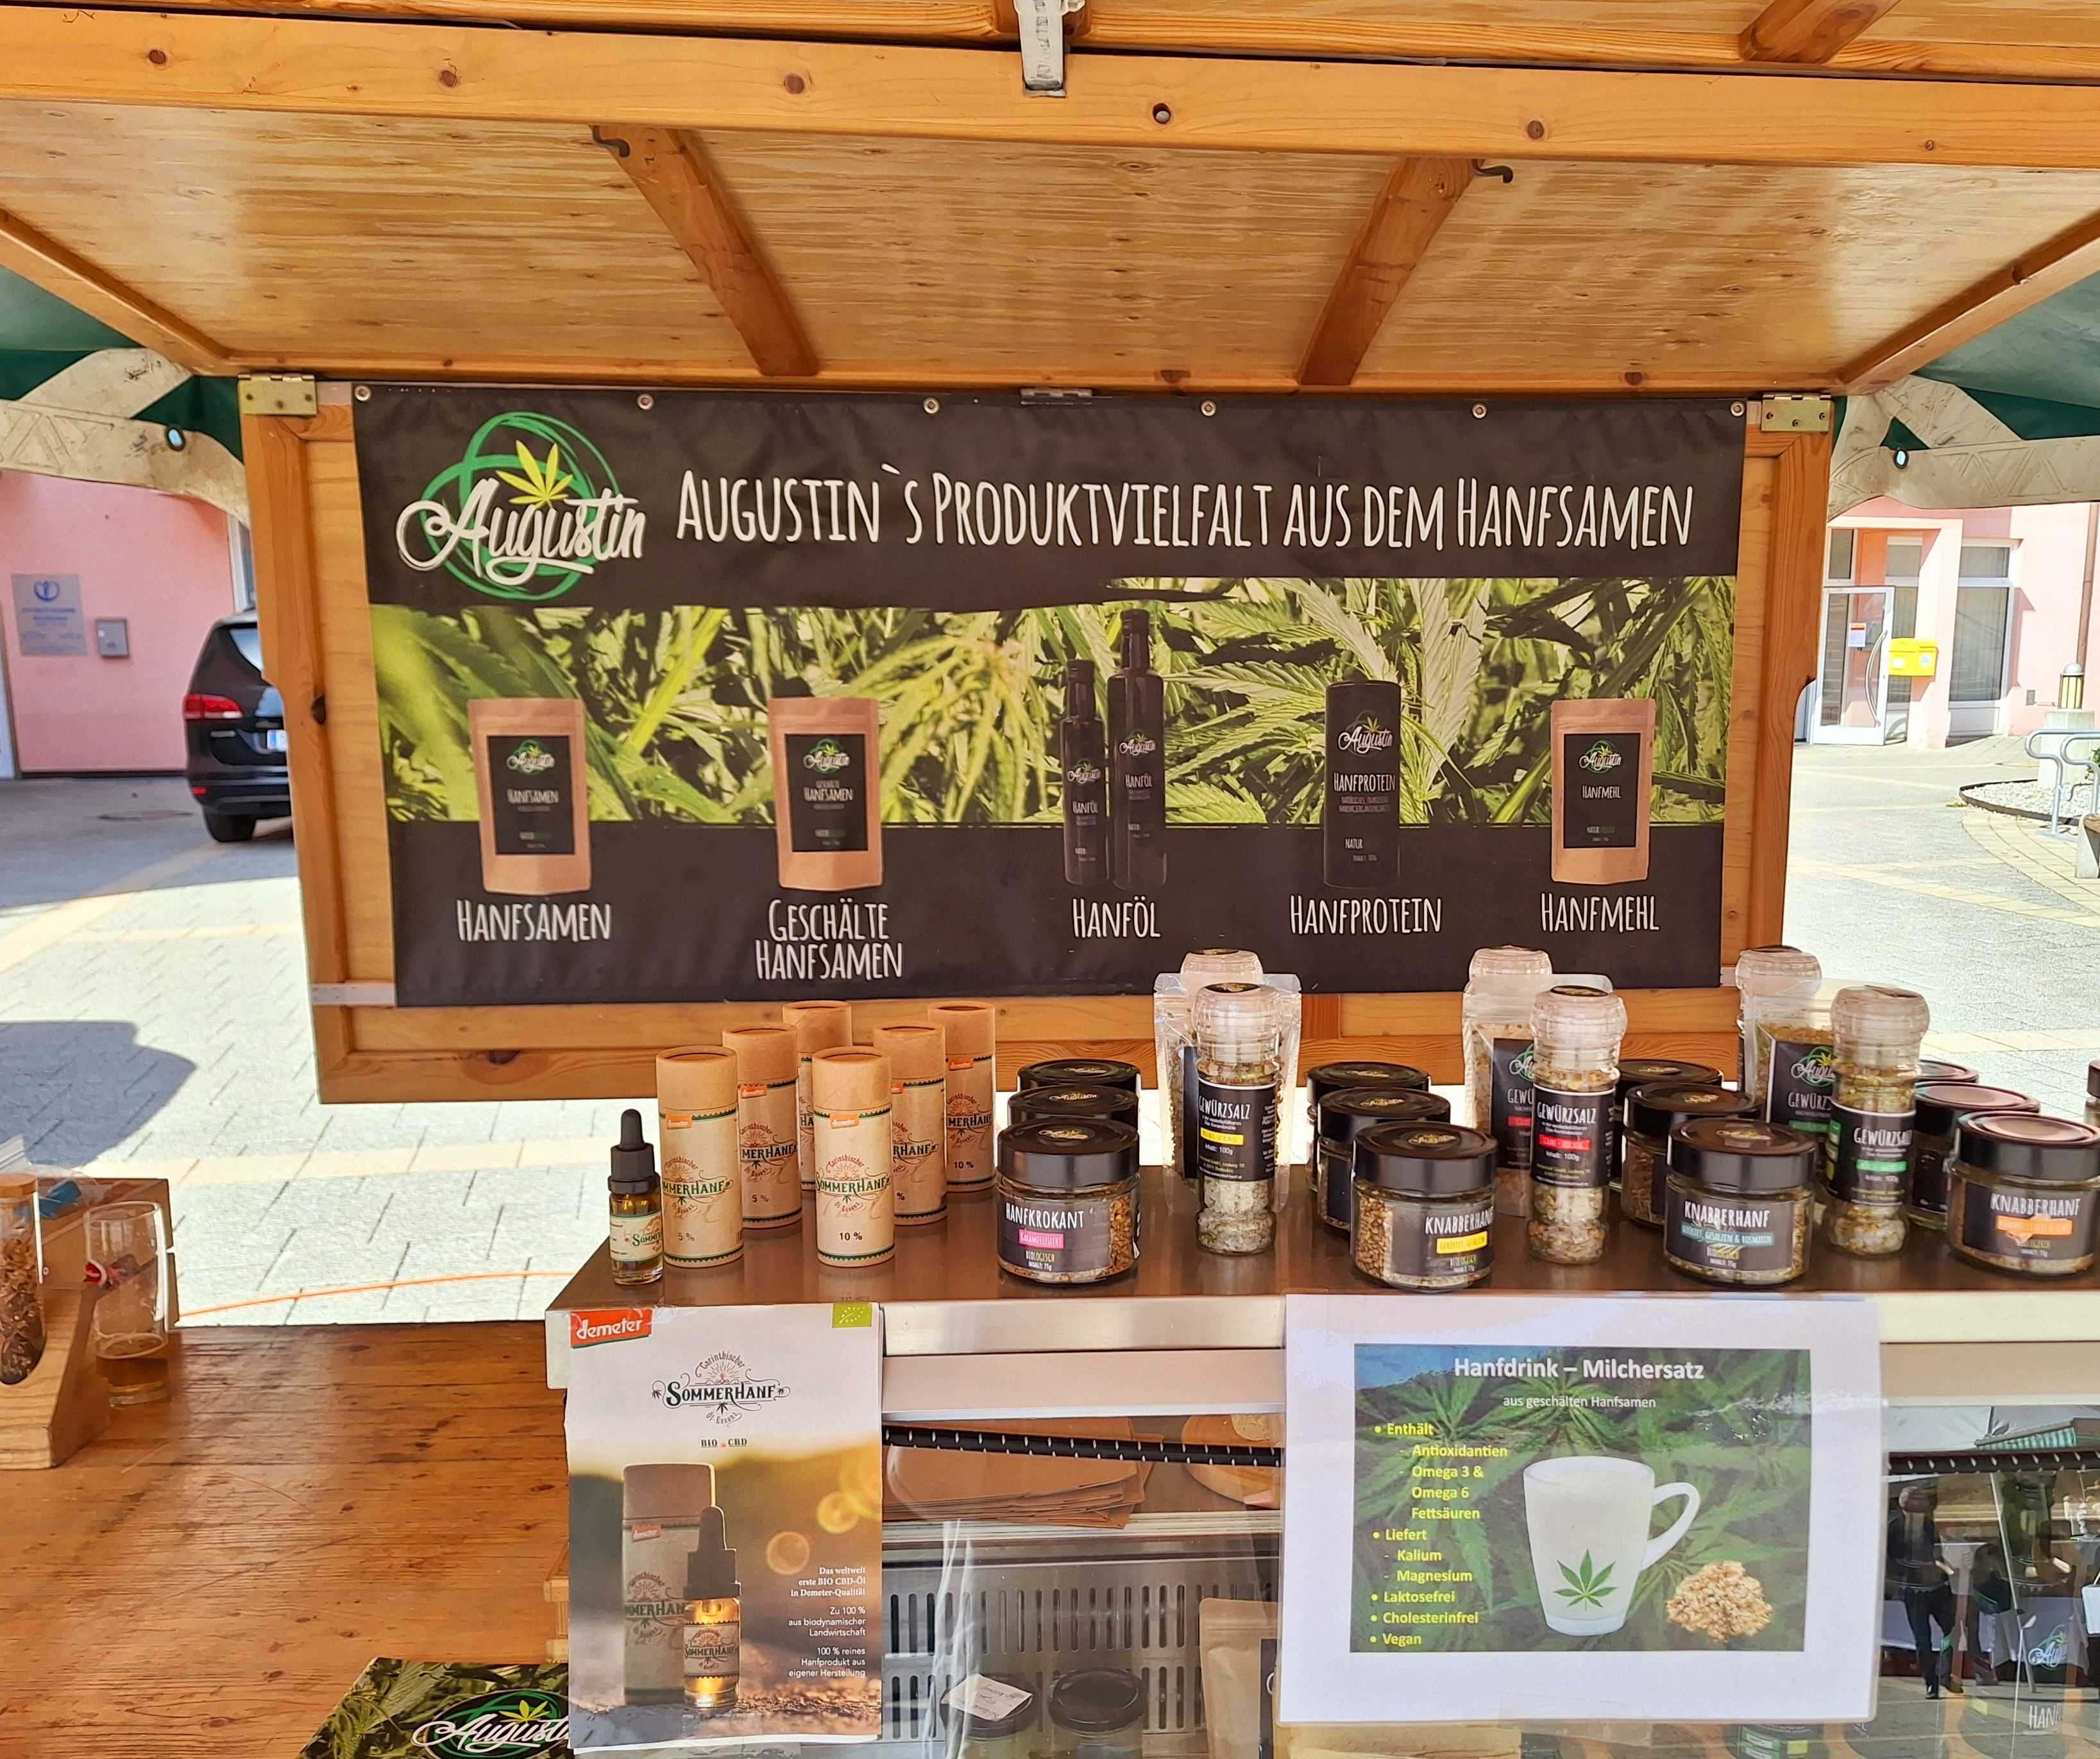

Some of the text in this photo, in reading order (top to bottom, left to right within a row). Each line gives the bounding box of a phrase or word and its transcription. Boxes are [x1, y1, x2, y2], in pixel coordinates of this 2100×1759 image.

[933, 472, 1273, 548] PRODUKTVIELFALT
[1283, 483, 1351, 548] AUS
[1364, 484, 1443, 551] DEM
[1457, 477, 1693, 550] HANFSAMEN
[396, 477, 647, 585] Augustin
[1338, 726, 1393, 753] Augustin
[1579, 752, 1622, 770] Augustin
[1125, 773, 1153, 787] HANFÖL
[1334, 772, 1396, 792] HANFPROTEIN
[507, 788, 559, 804] HANFSAMEN
[804, 787, 854, 801] HANFSAMEN
[1582, 785, 1621, 799] HANFMEHL
[768, 898, 889, 941] GESCHÄLTE
[1072, 895, 1161, 939] HANFÖL
[1289, 895, 1441, 935] HANFPROTEIN
[1540, 893, 1660, 932] HANFMEHL
[457, 899, 612, 942] HANFSAMEN
[755, 939, 903, 980] HANFSAMEN
[1199, 1096, 1251, 1120] GEWÜRZSALZ
[1537, 1102, 1597, 1124] GEWÜRZSALZ
[947, 1113, 992, 1127] MERHANF
[1219, 1146, 1233, 1156] 100g
[1564, 1153, 1580, 1161] 100g
[815, 1175, 886, 1192] SOMMERHANF
[1990, 1193, 2081, 1216] KNABBERHANF
[1006, 1202, 1084, 1229] HANFKROKANT
[1425, 1206, 1493, 1234] KNABBERHANF
[1684, 1200, 1770, 1228] KNABBERHANF
[678, 1233, 695, 1241] 5 %
[839, 1232, 863, 1241] 10 %
[1734, 1234, 1740, 1243] &
[576, 1317, 643, 1340] demeter
[696, 1351, 745, 1371] Carinthischer
[1454, 1358, 1559, 1378] Hanfdrink
[1583, 1358, 1705, 1380] Milchersatz
[666, 1381, 777, 1406] SOMMERHANF
[1503, 1395, 1656, 1410] aus geschälten Hanfsamen
[1387, 1422, 1434, 1435] Enthält
[701, 1438, 747, 1447] BIO CBD
[1412, 1445, 1508, 1457] Antioxidantien
[1412, 1465, 1484, 1480] Omega 3 &
[1412, 1486, 1469, 1501] Omega 6
[1412, 1507, 1480, 1519] Fettsäuren
[1385, 1528, 1428, 1540] Liefert
[1397, 1549, 1442, 1561] Kalium
[834, 1566, 866, 1574] weltweit
[1397, 1570, 1473, 1584] Magnesium
[834, 1576, 865, 1585] CBD-Öl
[800, 1588, 865, 1597] Demeter-Qualität
[1384, 1591, 1455, 1603] Laktosefrei
[804, 1617, 866, 1628] biodynamischer
[1382, 1612, 1479, 1624] Cholesterinfrei
[809, 1628, 866, 1637] Landwirtschaft
[1382, 1633, 1422, 1647] Vegan
[801, 1658, 850, 1667] Hanfprodukt
[788, 1669, 866, 1678] eigener Herstellung
